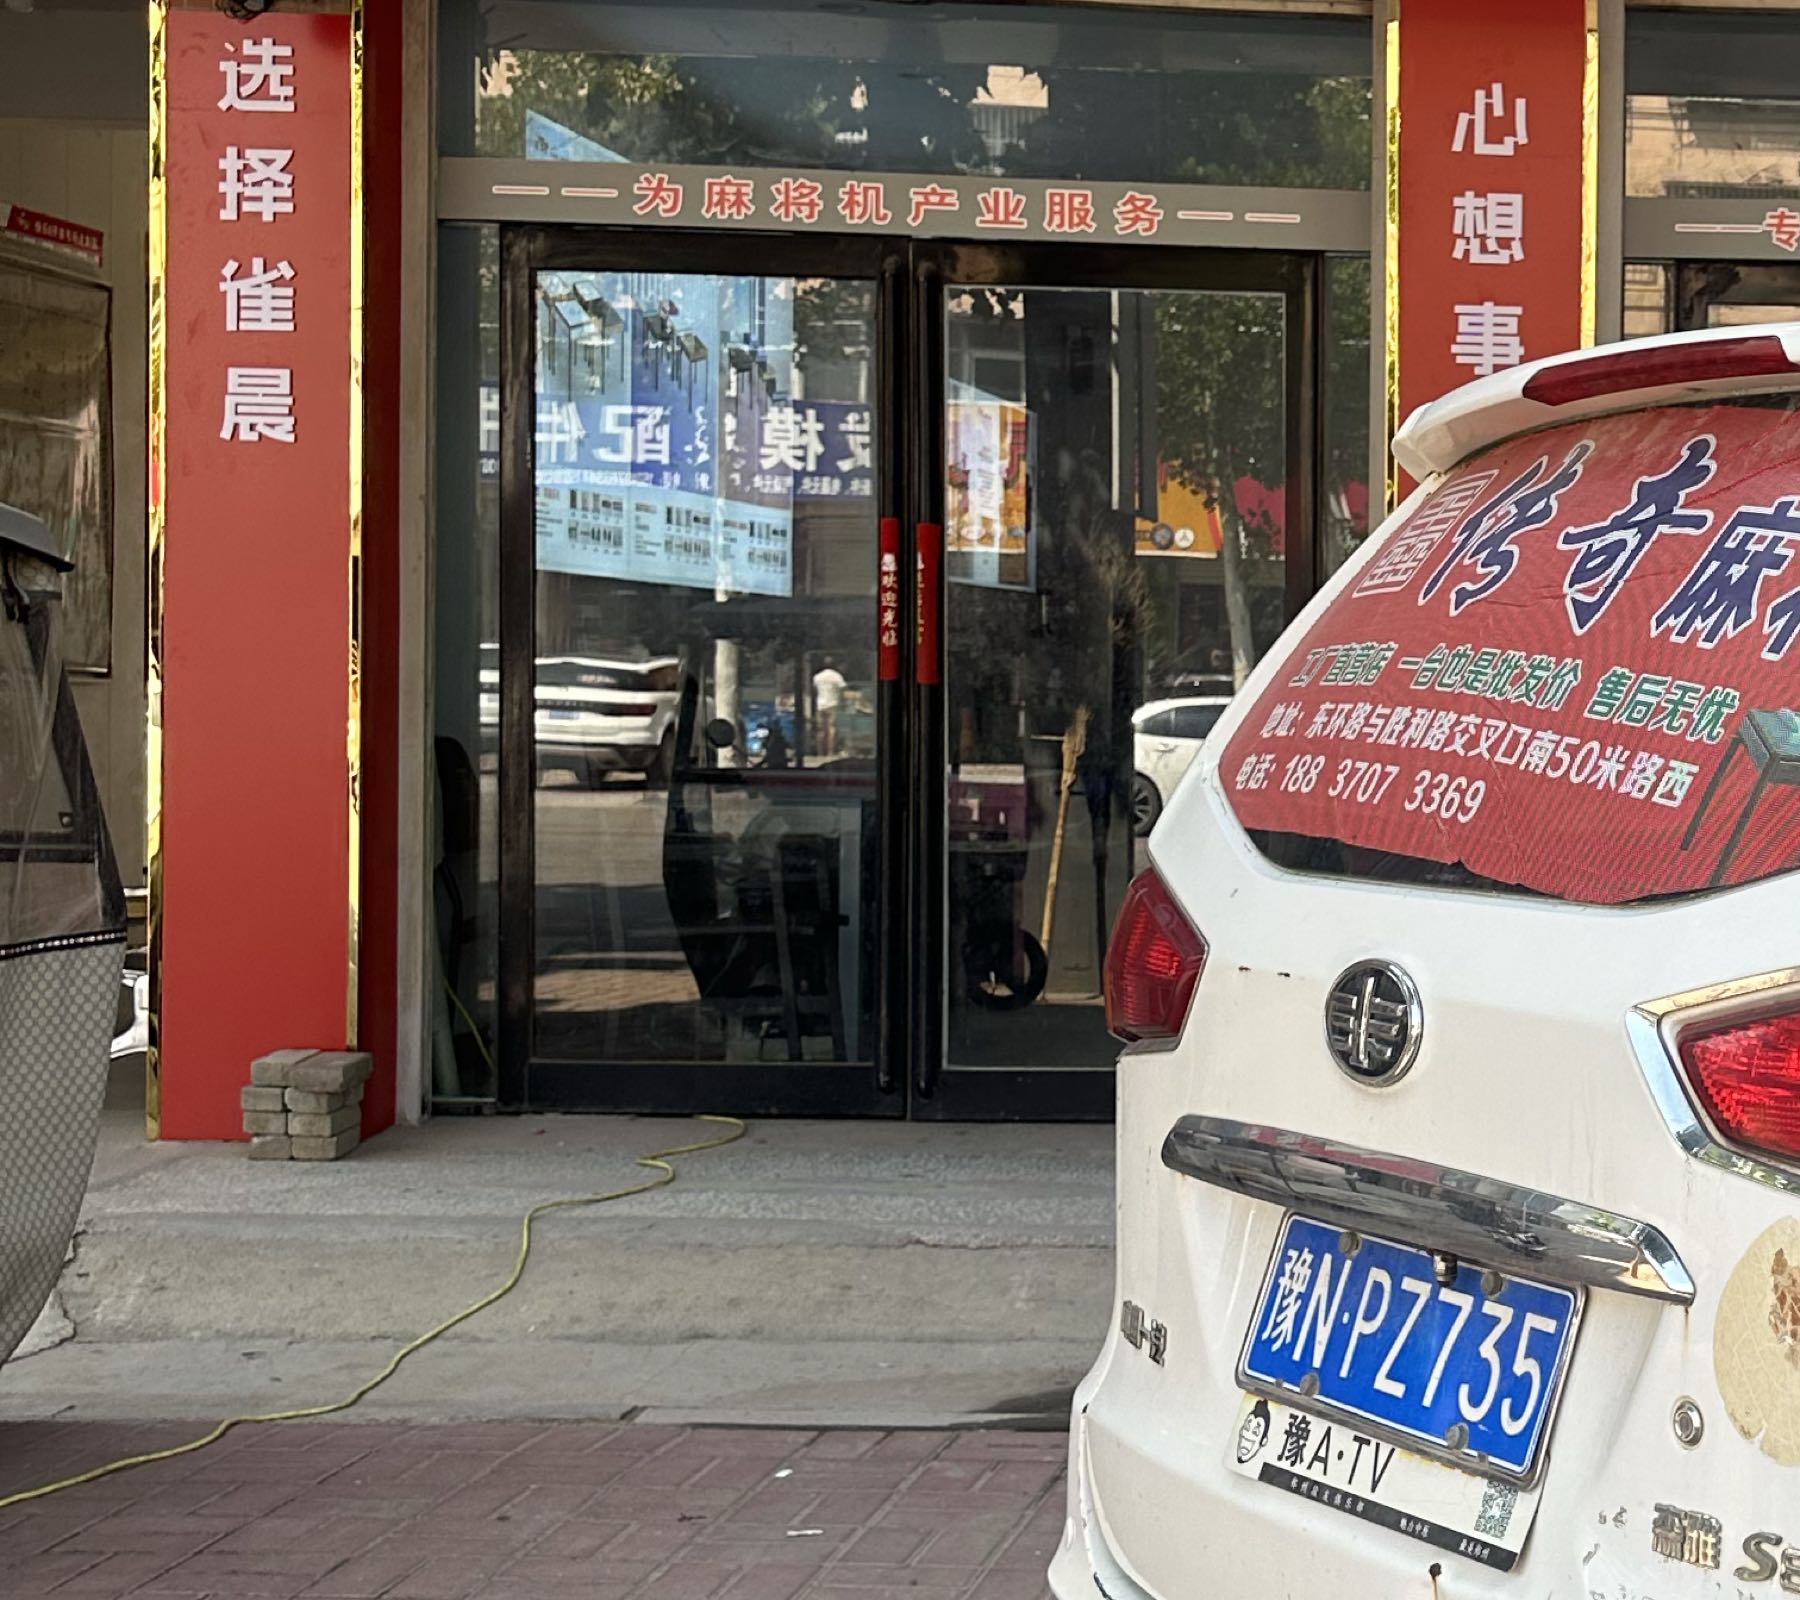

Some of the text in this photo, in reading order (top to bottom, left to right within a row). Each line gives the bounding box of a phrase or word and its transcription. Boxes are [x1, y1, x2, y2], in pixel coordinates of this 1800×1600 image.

[217, 36, 296, 445] 选择雀晨
[1397, 642, 1583, 712] 一台也是批发价
[1583, 665, 1741, 745] 售后无忧
[1279, 753, 1326, 794] 188
[1328, 758, 1400, 805] 3707
[1404, 769, 1487, 824] 3369
